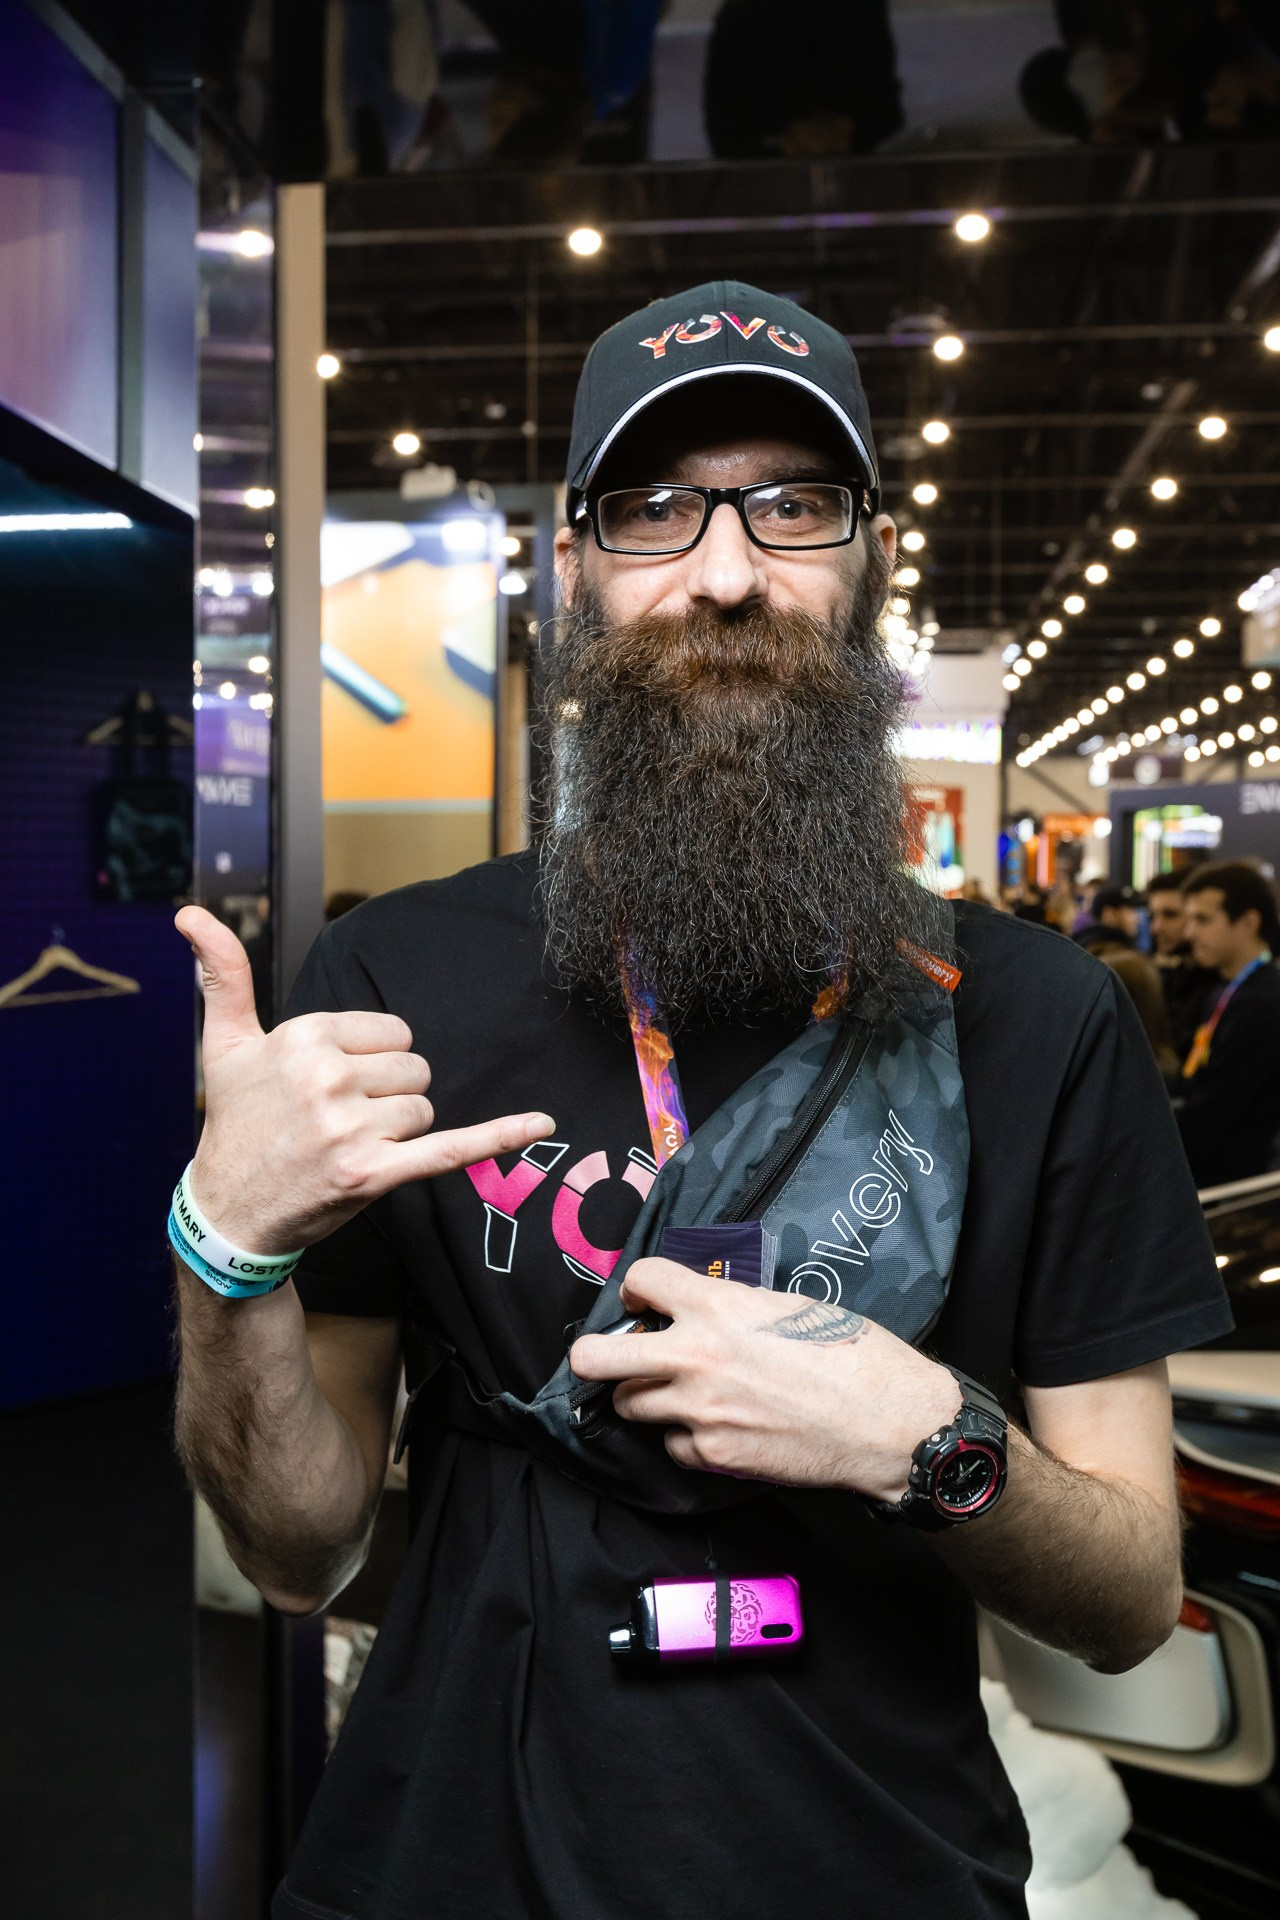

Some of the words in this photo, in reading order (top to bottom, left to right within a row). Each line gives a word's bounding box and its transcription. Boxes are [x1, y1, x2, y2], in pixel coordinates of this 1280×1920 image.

[638, 311, 810, 360] YOVO
[178, 1200, 206, 1243] MARY
[205, 1269, 232, 1290] SHOW
[227, 1256, 280, 1275] LOST
